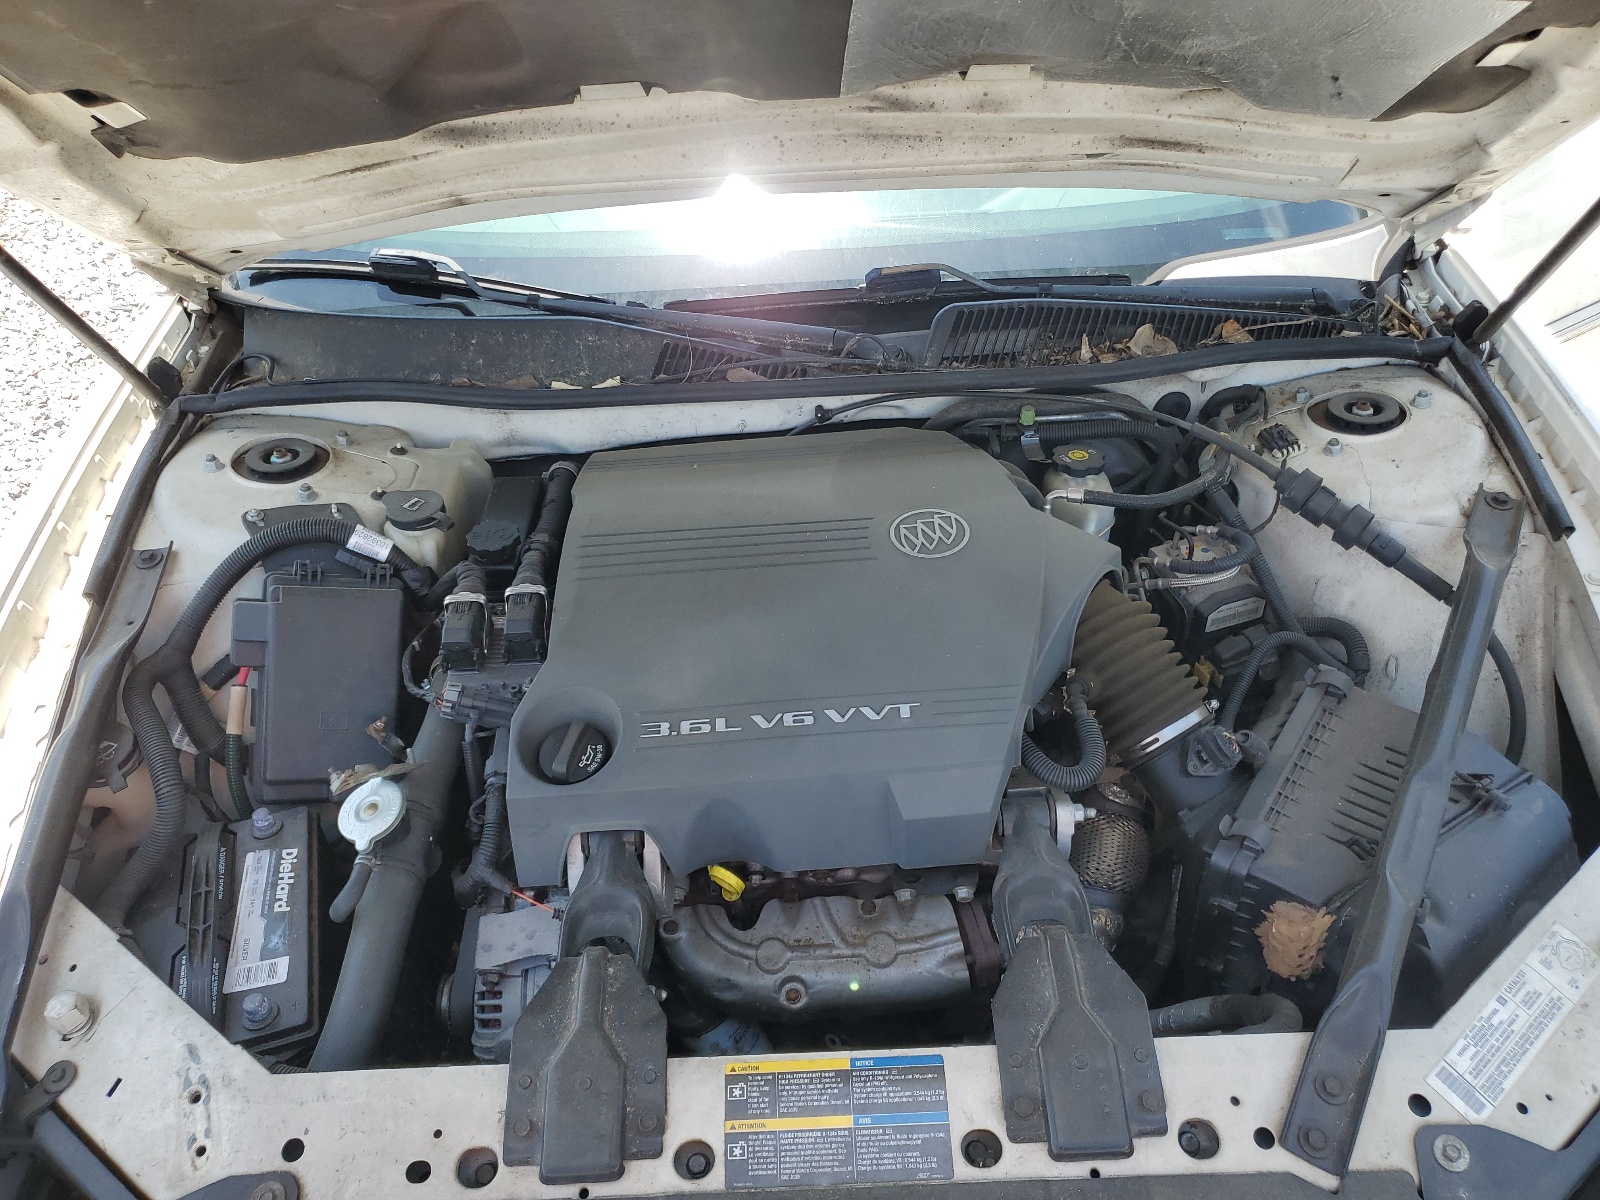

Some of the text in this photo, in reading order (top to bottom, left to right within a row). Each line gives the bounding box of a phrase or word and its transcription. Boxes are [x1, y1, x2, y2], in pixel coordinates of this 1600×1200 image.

[640, 702, 920, 738] 3.6L V6 VVT
[587, 761, 598, 773] SAE
[273, 848, 299, 913] DieHard
[241, 938, 251, 961] SILVER
[1503, 968, 1526, 994] CATALYST
